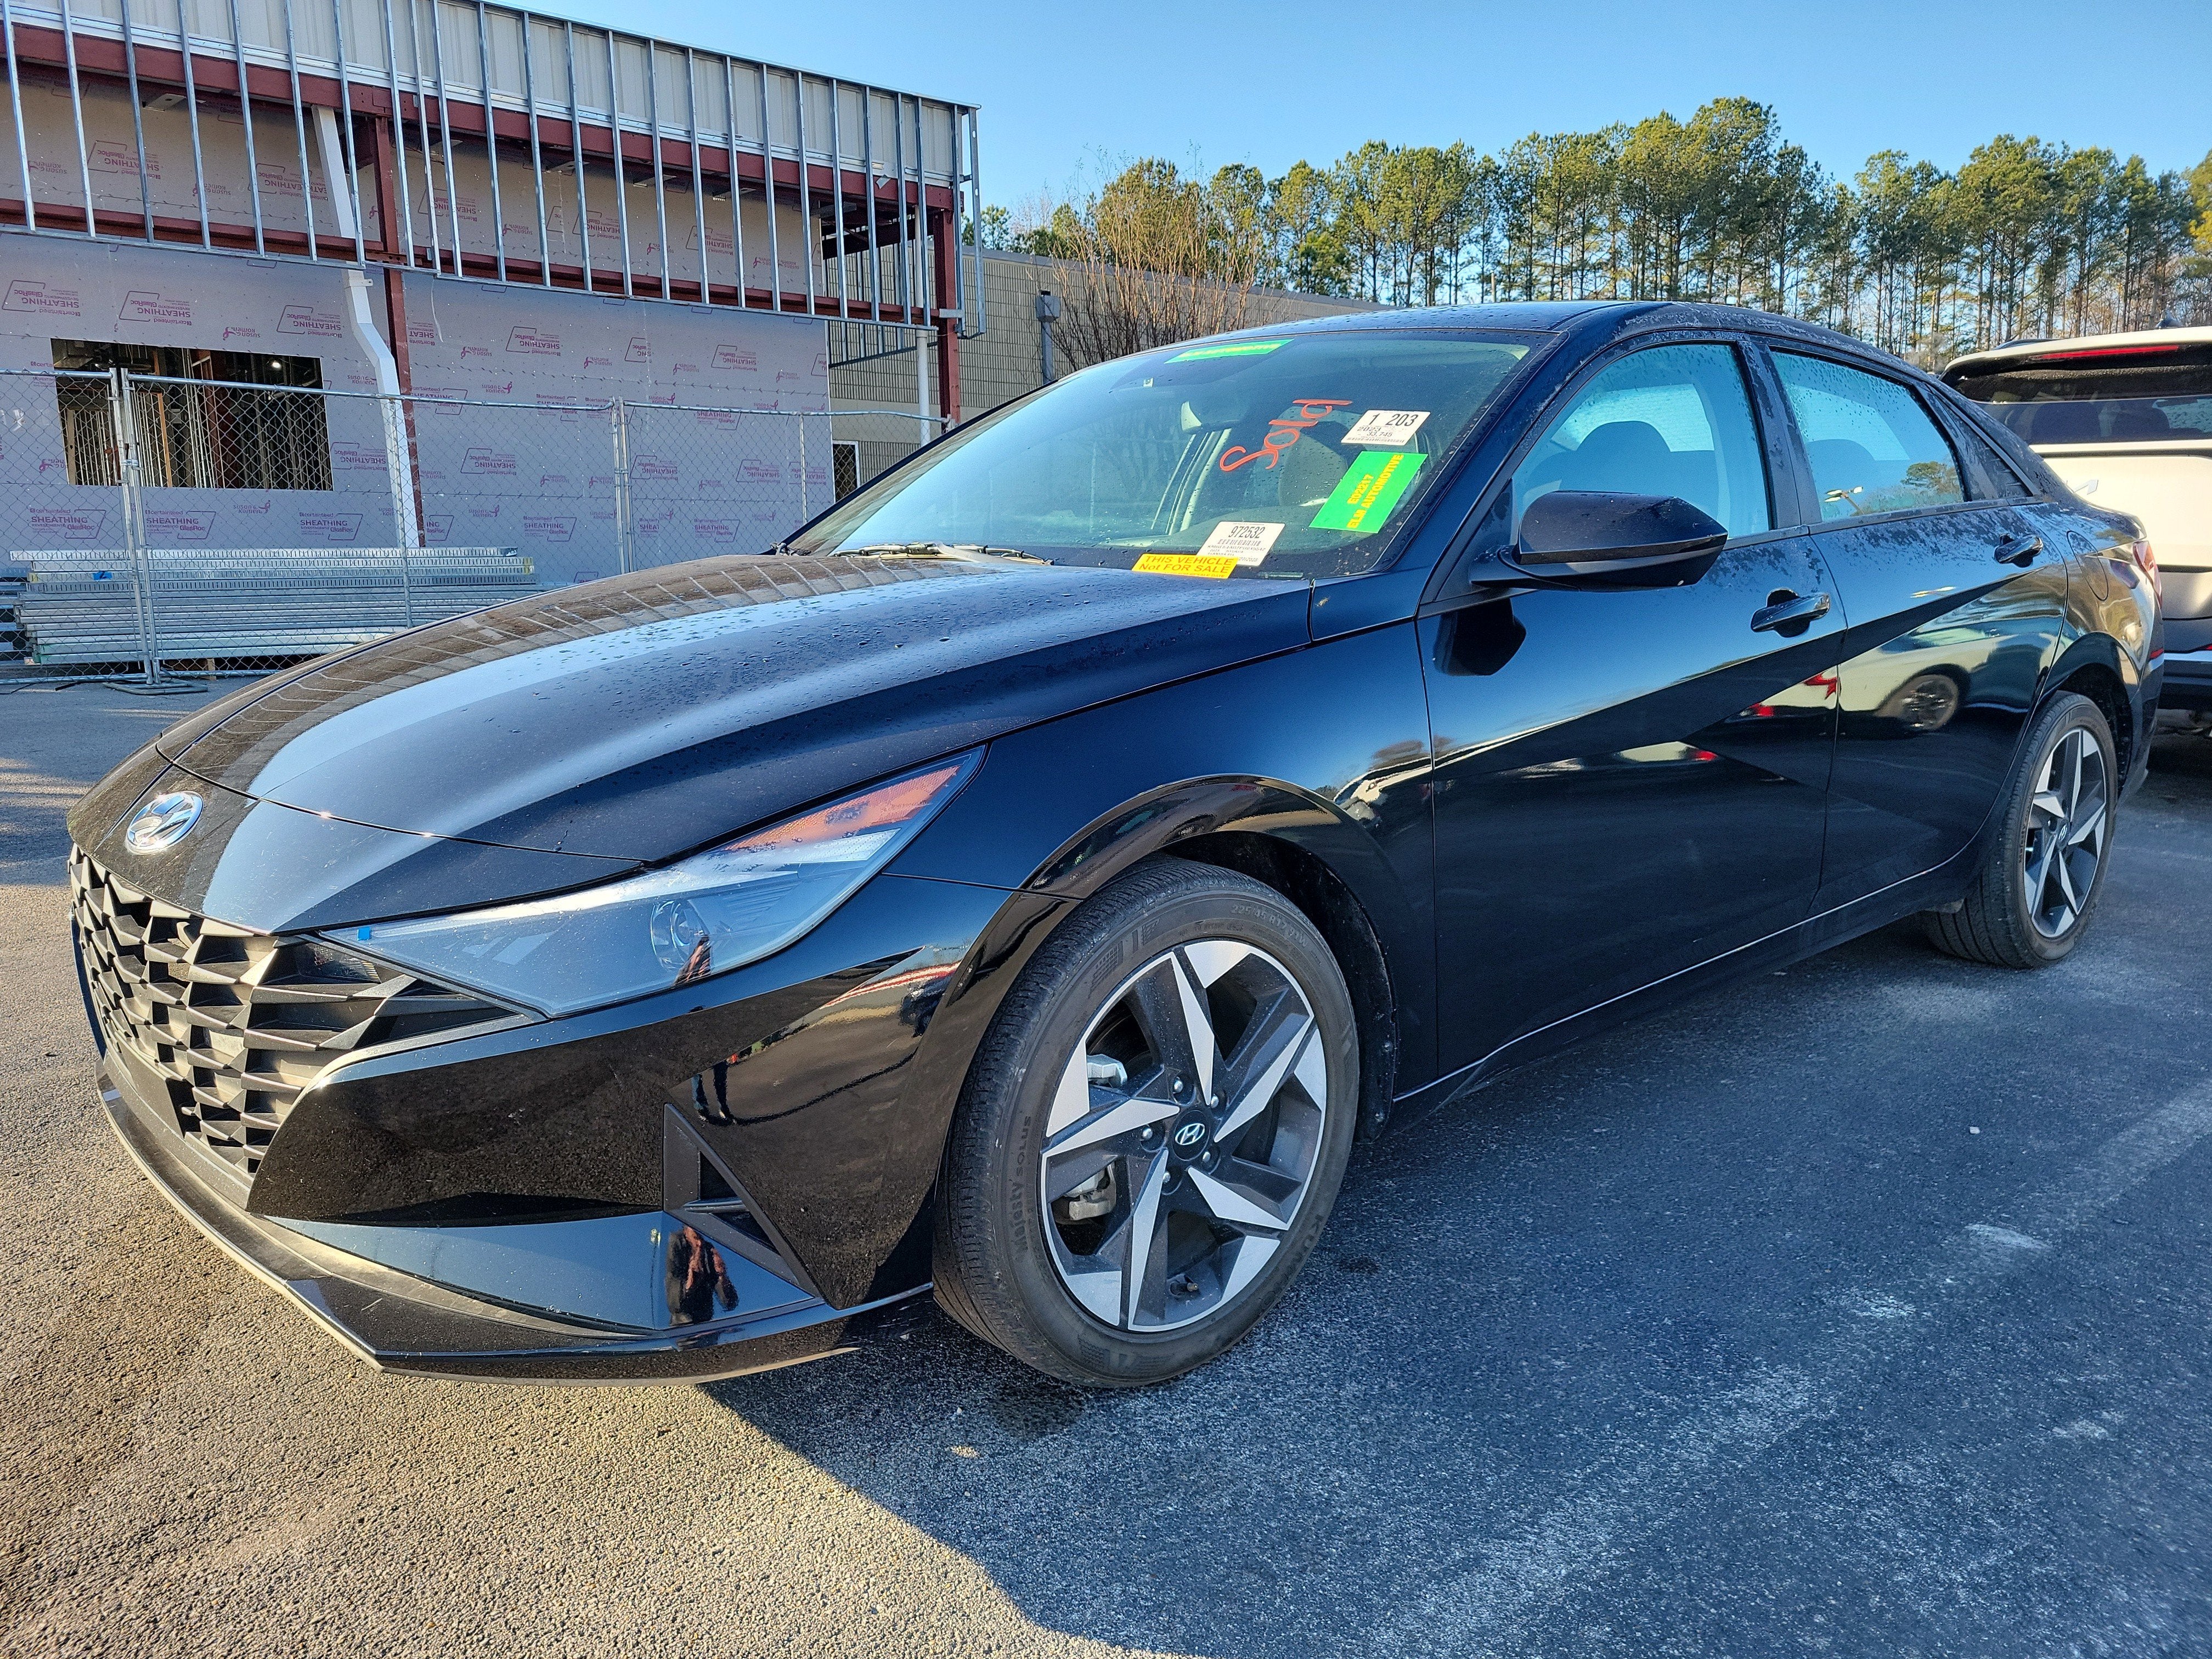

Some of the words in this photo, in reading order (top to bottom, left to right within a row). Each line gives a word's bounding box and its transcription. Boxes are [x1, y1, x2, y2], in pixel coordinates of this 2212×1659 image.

[104, 158, 159, 171] SHATHING
[587, 224, 620, 233] HEATHING
[21, 297, 80, 308] SHEATHING
[137, 308, 191, 318] SHEATHING
[294, 321, 341, 330] SHEATHING
[520, 340, 560, 349] SHEATHING
[723, 357, 757, 365] SHEATHING
[1369, 413, 1380, 425] 1
[1385, 413, 1419, 426] 203
[1220, 399, 1353, 471] Sold
[1361, 454, 1404, 508] AUTOMOTIVE
[1228, 526, 1265, 539] 972532
[1178, 557, 1234, 566] VEHICLE
